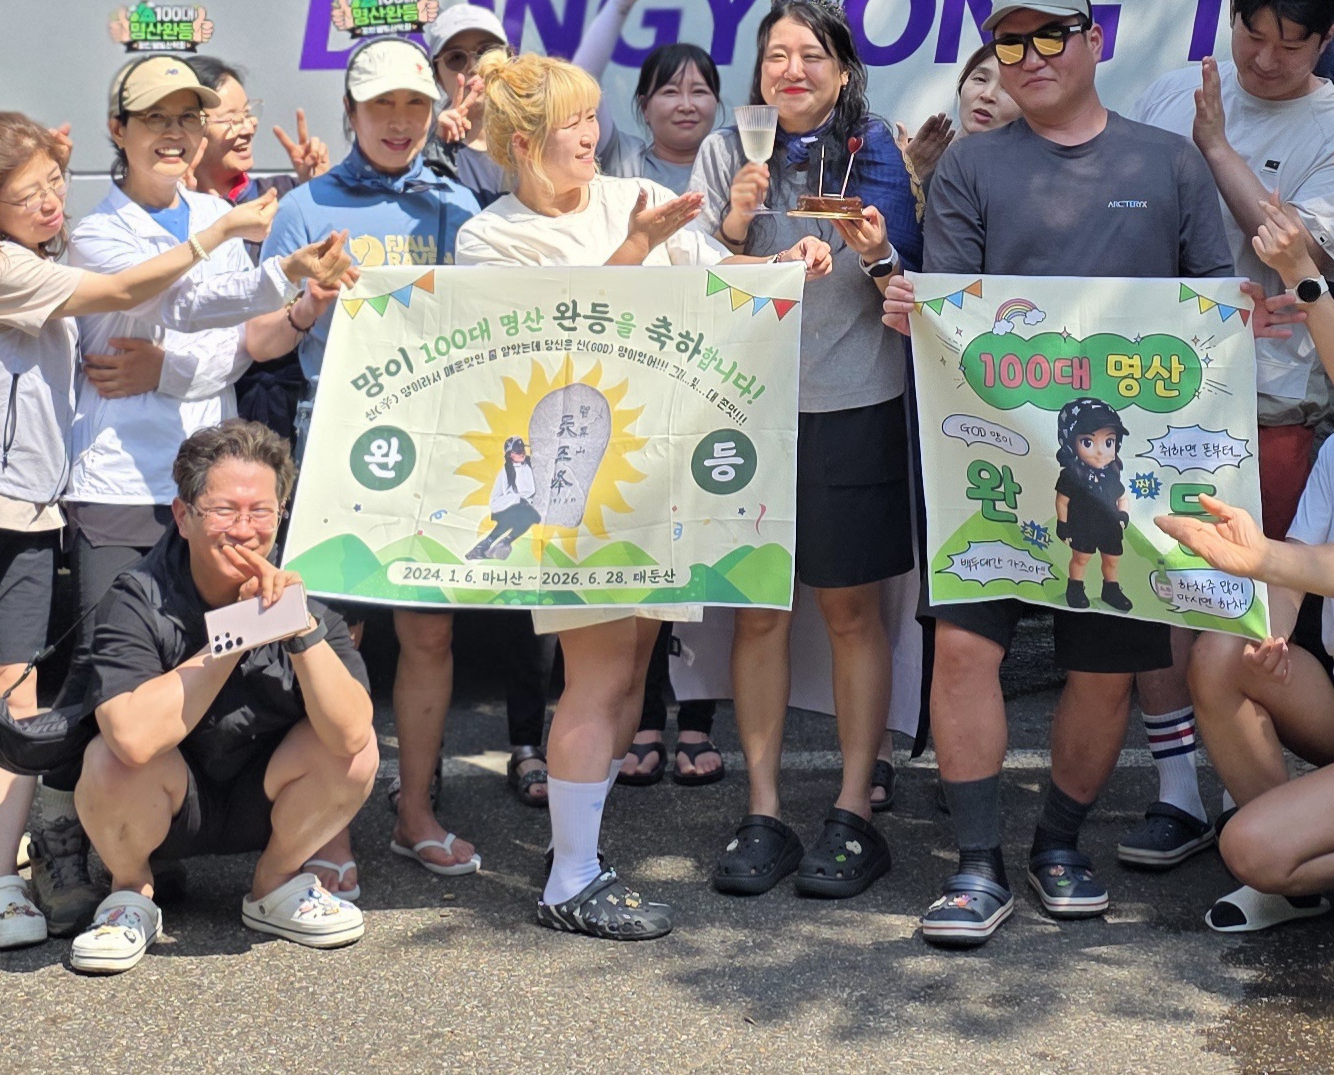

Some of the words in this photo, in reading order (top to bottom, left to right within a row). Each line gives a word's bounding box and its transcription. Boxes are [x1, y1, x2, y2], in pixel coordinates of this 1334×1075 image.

[154, 6, 194, 22] 100대
[352, 3, 418, 26] 명산완등
[130, 21, 193, 41] 명산완등
[419, 316, 492, 364] 100대
[499, 306, 545, 337] 명산
[552, 298, 637, 340] 완등을
[644, 315, 766, 405] 축하합니다!
[544, 338, 573, 352] 당신은
[576, 339, 614, 355] 신(GOD)
[978, 352, 1092, 391] 100대
[1105, 353, 1186, 398] 명산
[960, 422, 987, 438] GOD
[363, 436, 403, 479] 완
[1159, 441, 1198, 458] 취하면
[703, 440, 745, 482] 등
[965, 458, 1023, 524] 완
[1024, 525, 1051, 547] 최고
[960, 556, 1004, 572] 백두대간
[402, 566, 445, 583] 2024.
[448, 569, 460, 583] 1.
[464, 570, 477, 585] 6.
[482, 569, 524, 586] 마니산
[541, 571, 584, 586] 2026.
[588, 571, 601, 585] 6.
[605, 570, 629, 585] 28.
[632, 567, 676, 585] 대둔산
[1176, 593, 1214, 609] 마시면
